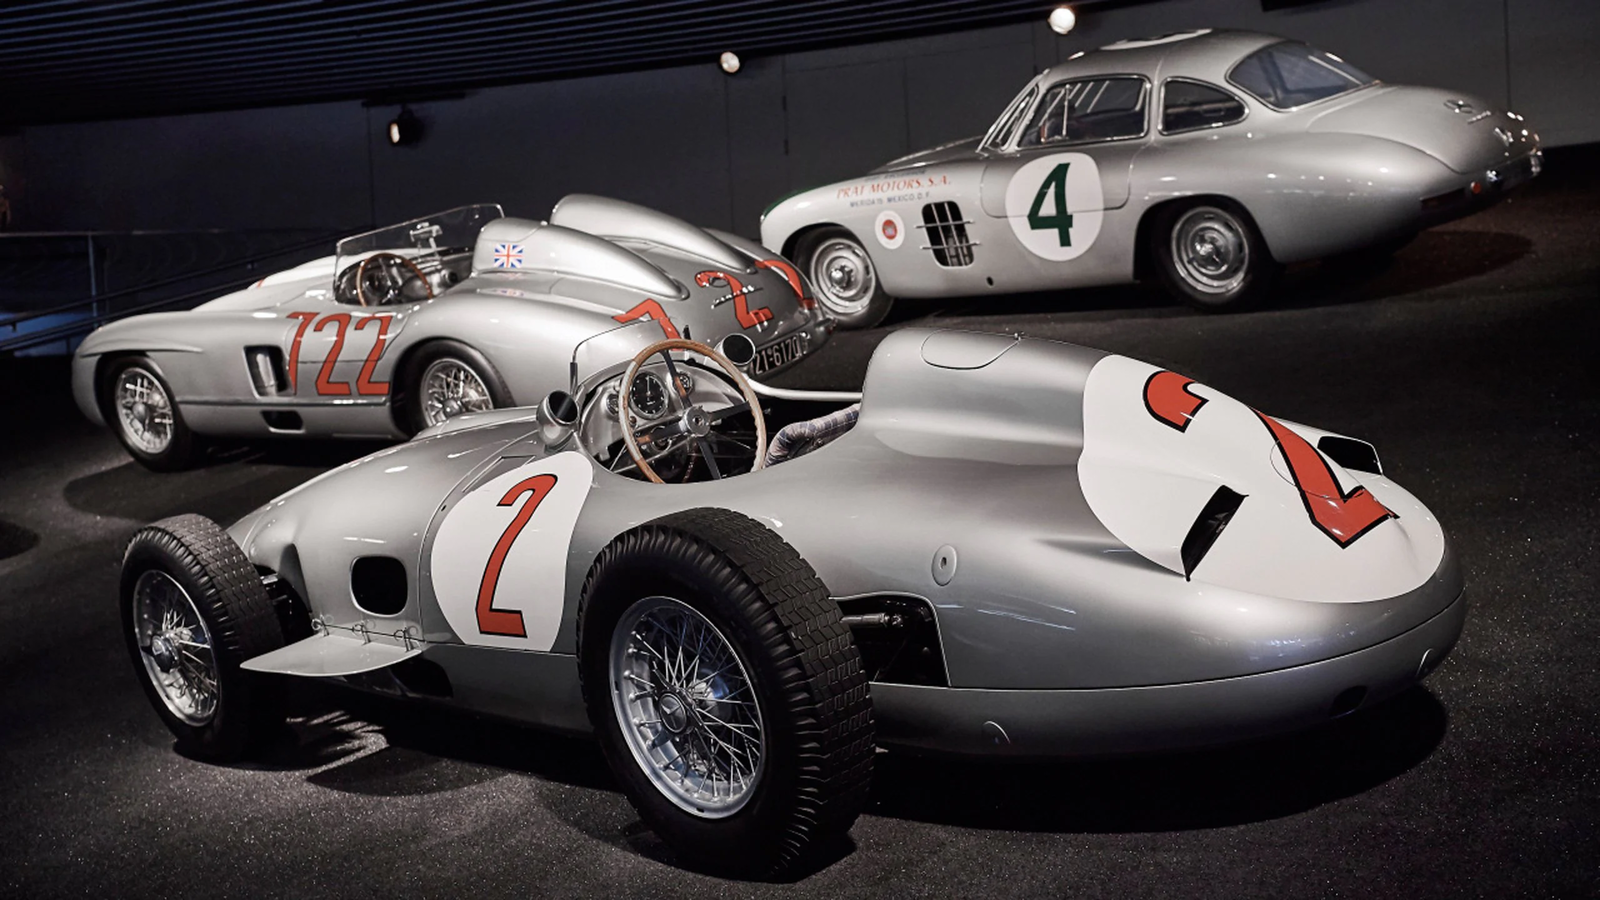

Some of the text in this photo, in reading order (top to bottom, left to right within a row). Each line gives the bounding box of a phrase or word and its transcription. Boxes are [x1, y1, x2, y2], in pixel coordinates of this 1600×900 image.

[836, 185, 864, 199] PRAT
[1027, 163, 1074, 247] 4
[286, 311, 393, 396] 722
[1142, 369, 1401, 550] 2
[475, 473, 559, 639] 2
